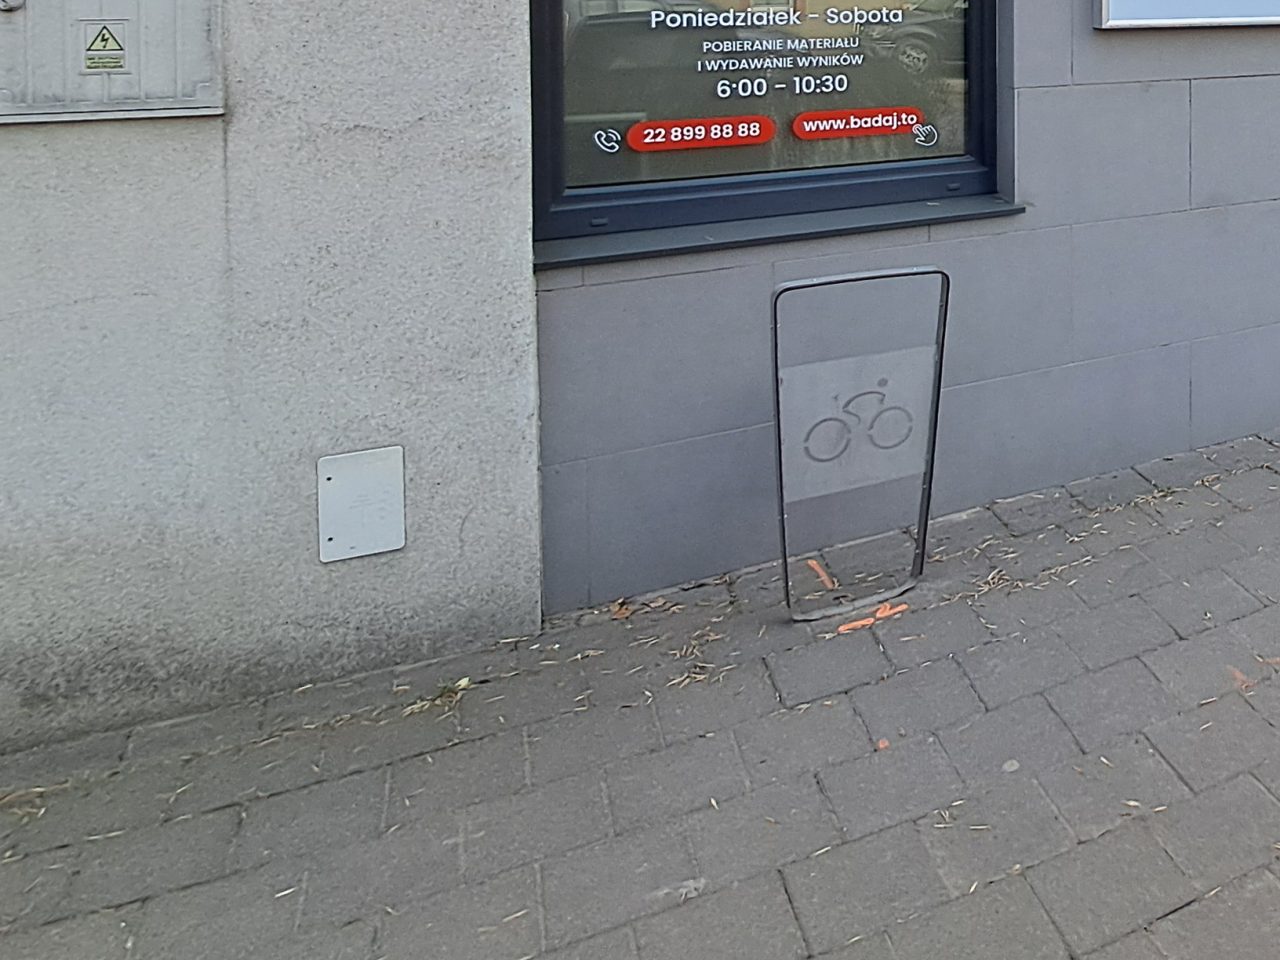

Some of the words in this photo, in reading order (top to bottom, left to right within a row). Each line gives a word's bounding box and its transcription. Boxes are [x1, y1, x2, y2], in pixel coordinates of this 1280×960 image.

[650, 7, 801, 29] Poniedziałek
[826, 6, 903, 25] Sobota
[702, 39, 784, 53] POBIERANIE
[786, 36, 860, 50] MATERIAŁU
[697, 60, 702, 72] I
[705, 56, 794, 71] WYDAWANIE
[796, 52, 864, 67] WYNIKÓW
[716, 78, 768, 98] 6:00
[793, 74, 848, 94] 10:30
[803, 111, 917, 132] www.badaj.to
[643, 128, 668, 144] 22
[670, 126, 705, 142] 899
[710, 124, 735, 140] 88
[737, 122, 761, 138] 88
